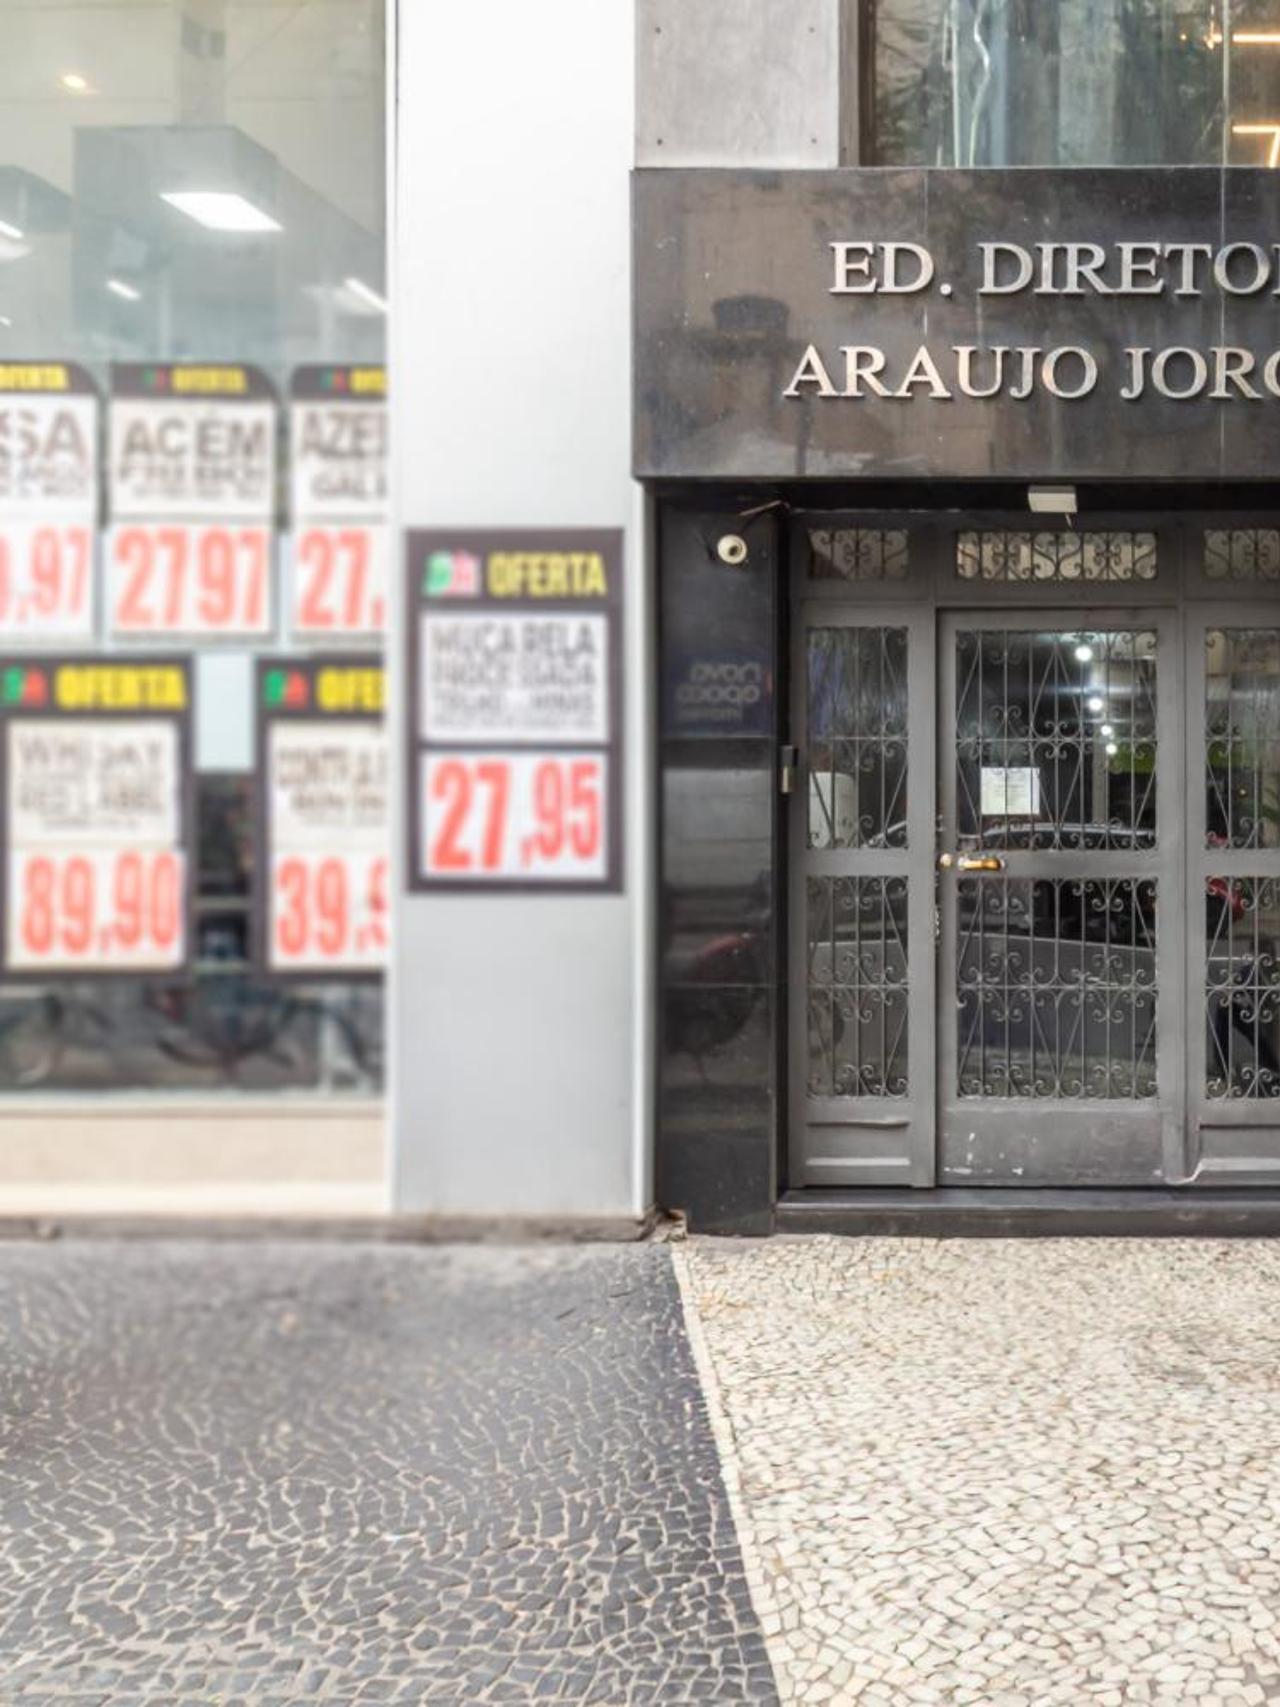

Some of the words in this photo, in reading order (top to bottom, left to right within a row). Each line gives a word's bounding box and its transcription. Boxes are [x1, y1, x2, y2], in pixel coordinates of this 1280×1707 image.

[828, 241, 953, 297] ED.
[782, 344, 1099, 400] ARAUJO
[487, 551, 606, 597] OFERTA
[430, 759, 600, 870] 27,95
[22, 853, 182, 956] 89,90
